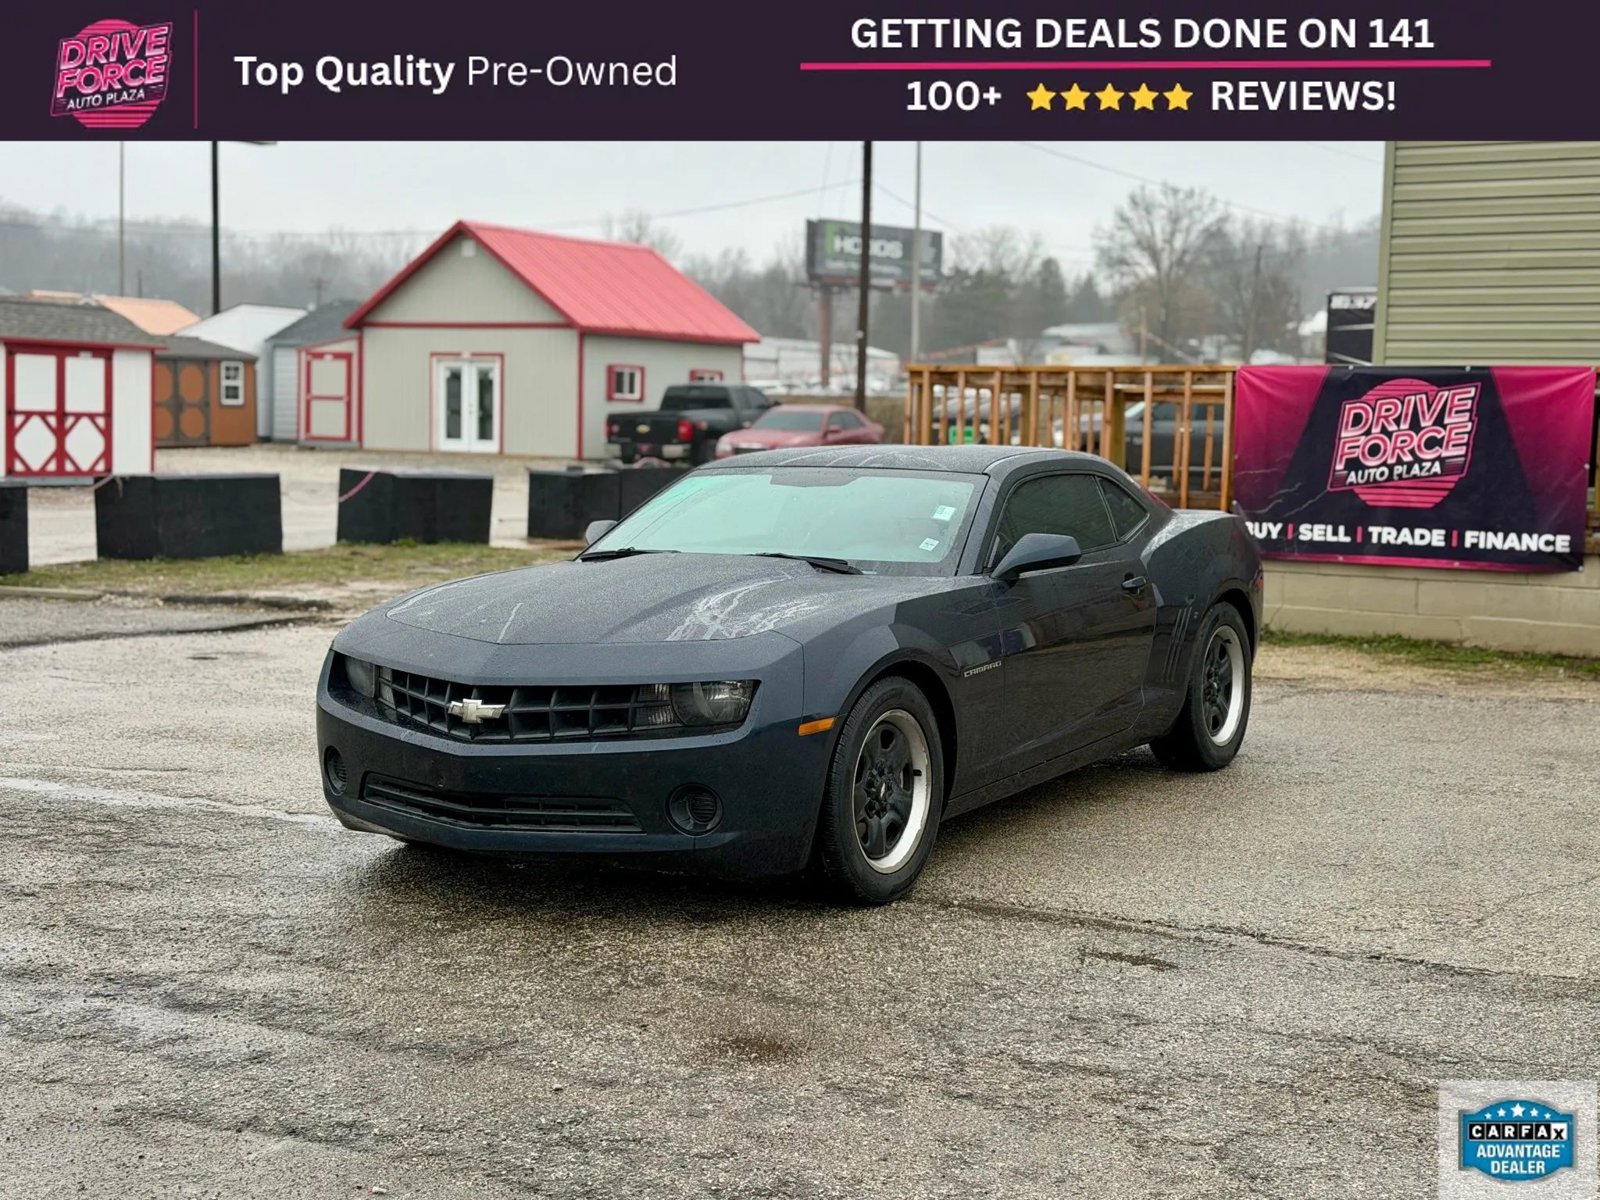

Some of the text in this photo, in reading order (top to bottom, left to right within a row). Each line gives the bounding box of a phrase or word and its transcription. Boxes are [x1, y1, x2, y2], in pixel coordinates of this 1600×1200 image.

[1340, 387, 1476, 438] DRIVE
[1335, 422, 1472, 470] FORCE
[1346, 461, 1441, 485] AUTO PLAZA
[1298, 523, 1351, 543] SELL
[1368, 526, 1446, 547] TRADE
[1464, 530, 1571, 553] FINANCE
[963, 660, 1002, 678] CAMARO
